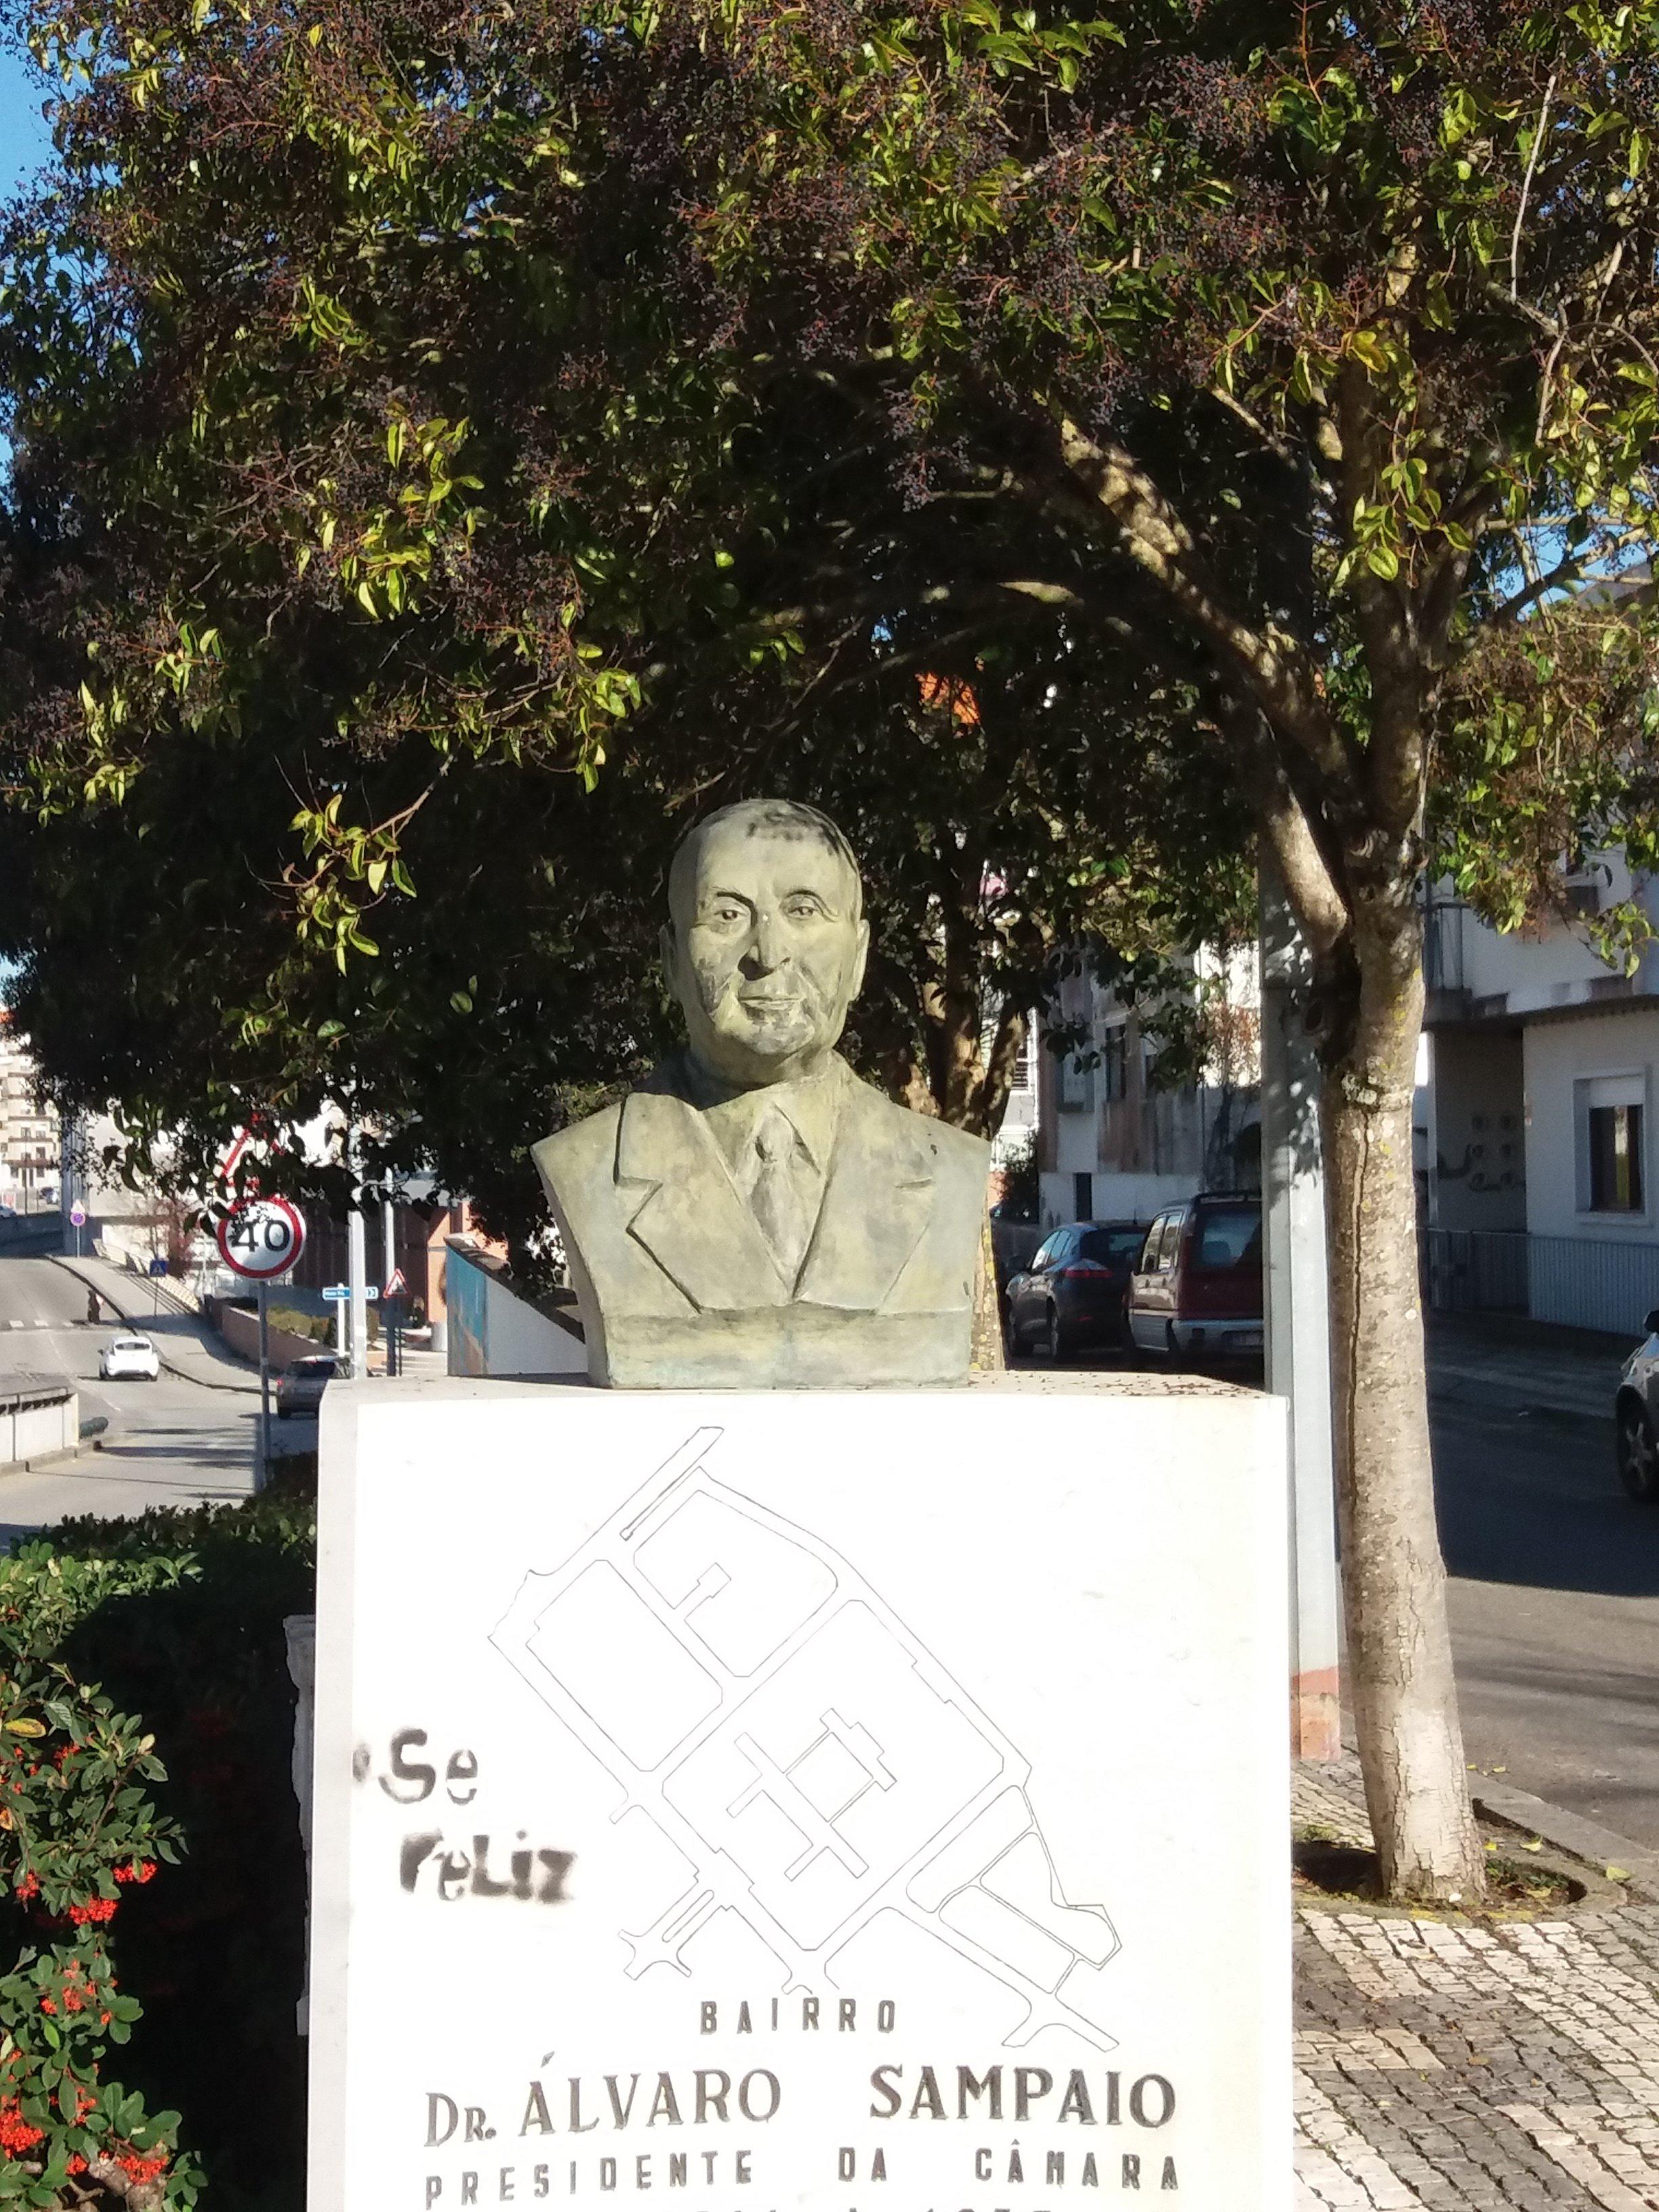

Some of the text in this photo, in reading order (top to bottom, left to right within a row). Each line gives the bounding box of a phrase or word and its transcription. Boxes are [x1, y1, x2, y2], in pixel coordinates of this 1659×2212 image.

[228, 1219, 290, 1252] 40
[377, 1727, 478, 1806] Se
[700, 1996, 896, 2035] BAIRRO
[518, 2051, 781, 2137] ÁLVARO
[869, 2064, 1176, 2129] SAMPAIO
[426, 2139, 1179, 2211] PRESIDENTE DA CÂMARA
